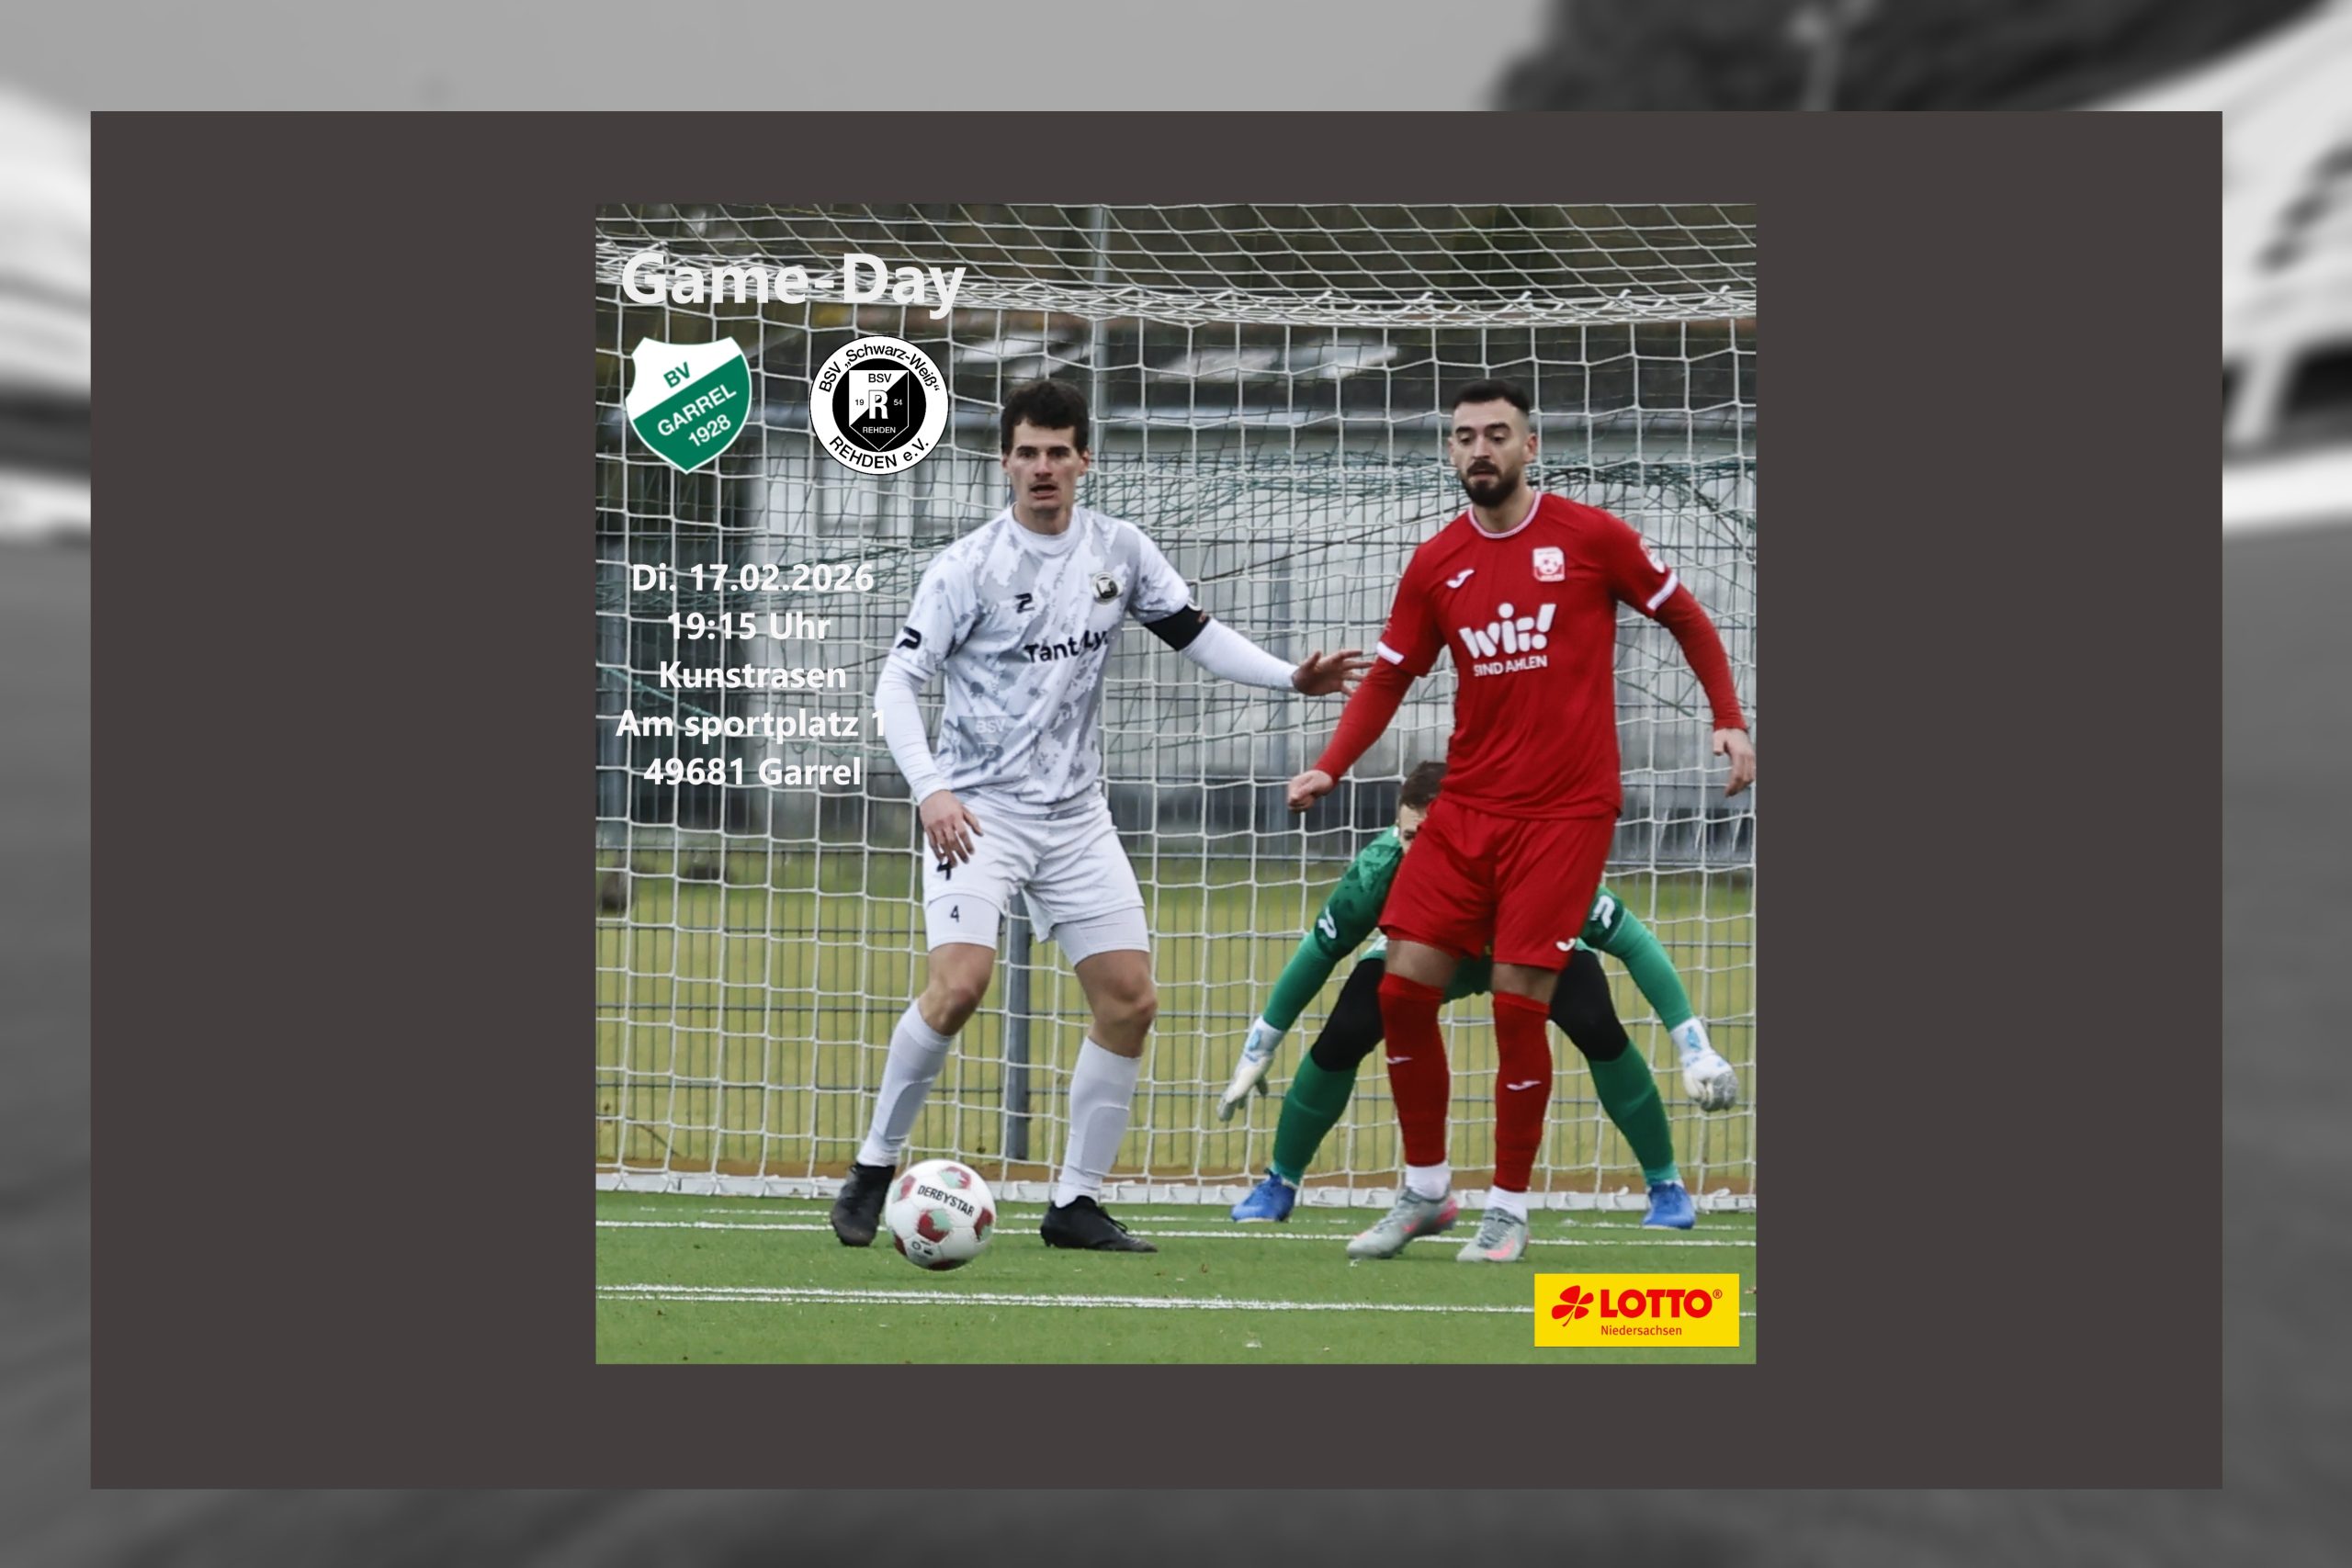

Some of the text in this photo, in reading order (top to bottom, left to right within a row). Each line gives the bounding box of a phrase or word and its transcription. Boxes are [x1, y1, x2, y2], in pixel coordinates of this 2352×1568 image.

[1505, 655, 1548, 673] AHLEN
[950, 905, 960, 923] 4
[917, 1184, 976, 1218] DERBYSTAR
